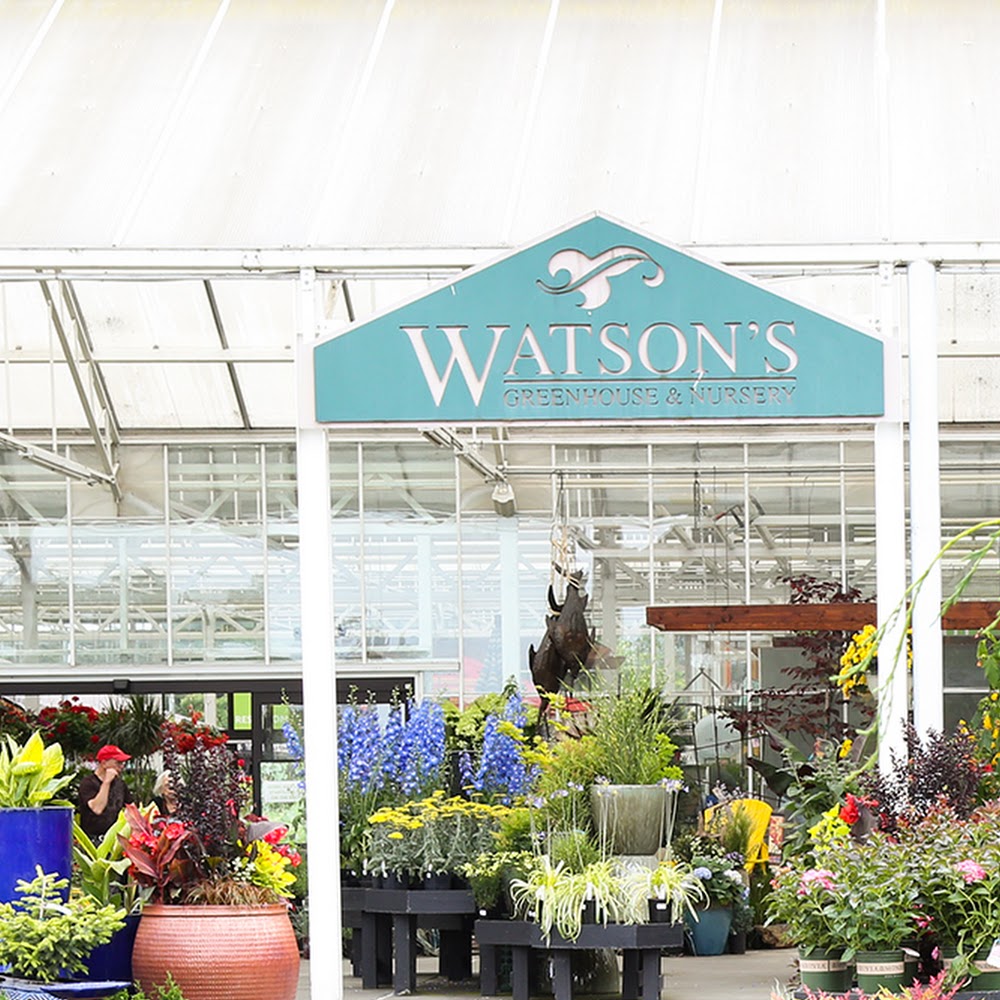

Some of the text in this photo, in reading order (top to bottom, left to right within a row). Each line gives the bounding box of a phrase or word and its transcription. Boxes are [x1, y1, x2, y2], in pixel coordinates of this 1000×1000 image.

[400, 320, 799, 407] WATSON'S
[503, 386, 796, 407] GREENHOUSE & NURSERY
